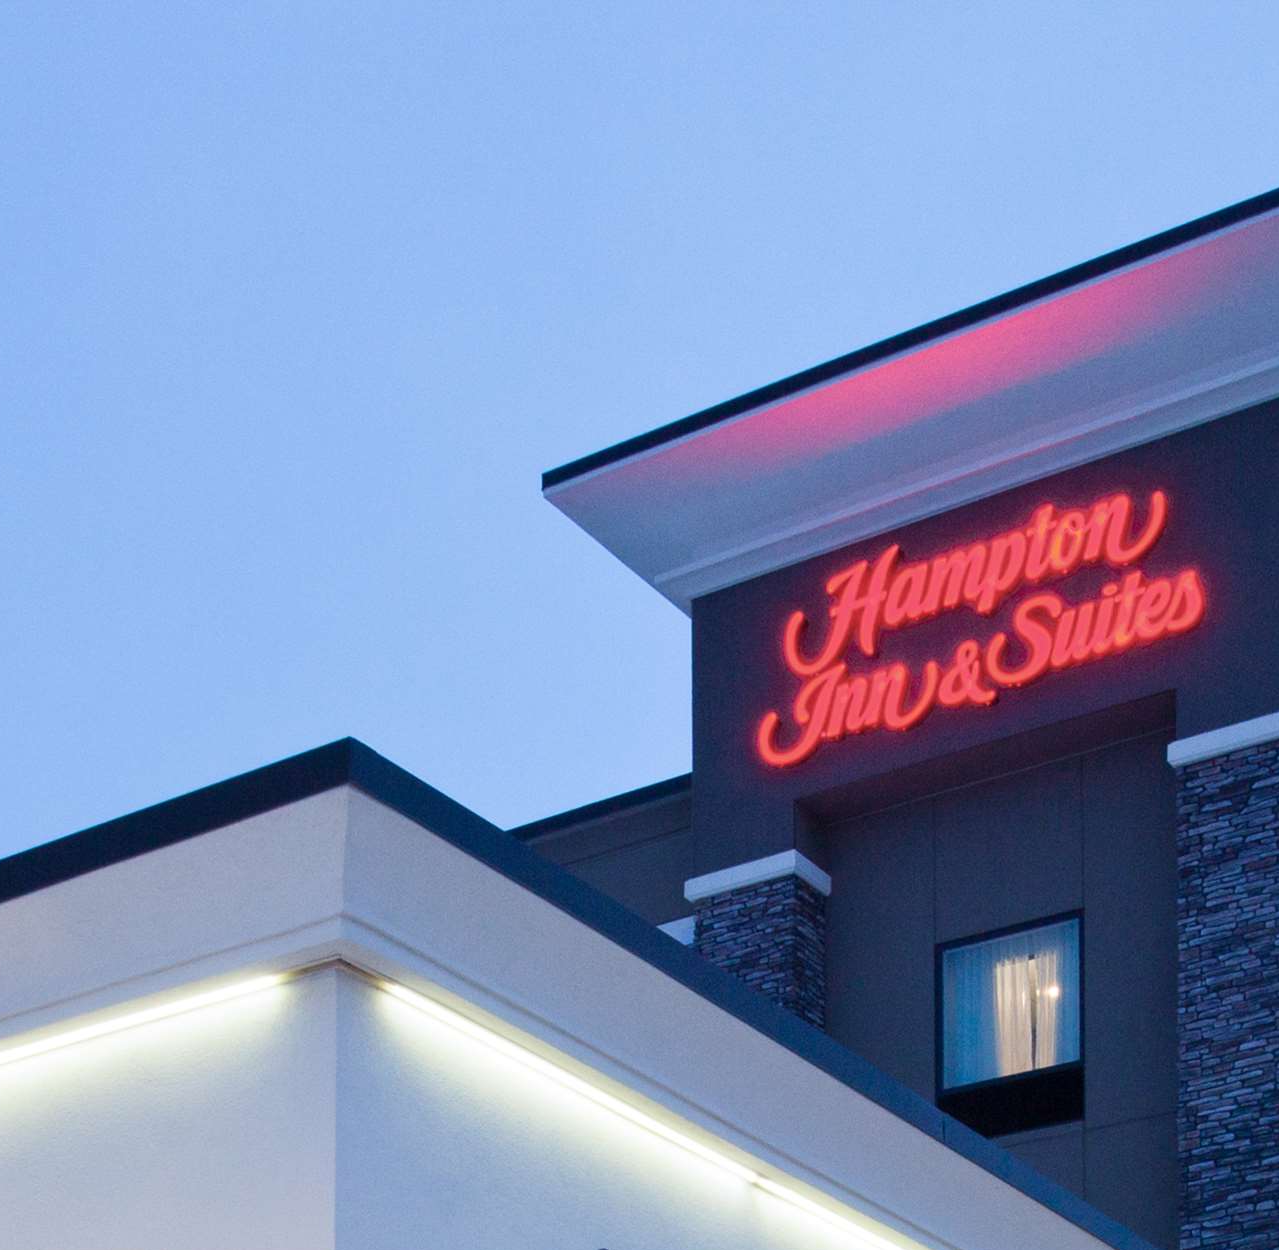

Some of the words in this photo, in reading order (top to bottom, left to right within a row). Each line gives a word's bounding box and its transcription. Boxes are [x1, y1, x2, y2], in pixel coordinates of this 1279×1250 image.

[757, 662, 936, 766] Inn
[938, 639, 997, 706] &
[986, 569, 1206, 686] Suites
[784, 491, 1168, 676] Hampton
